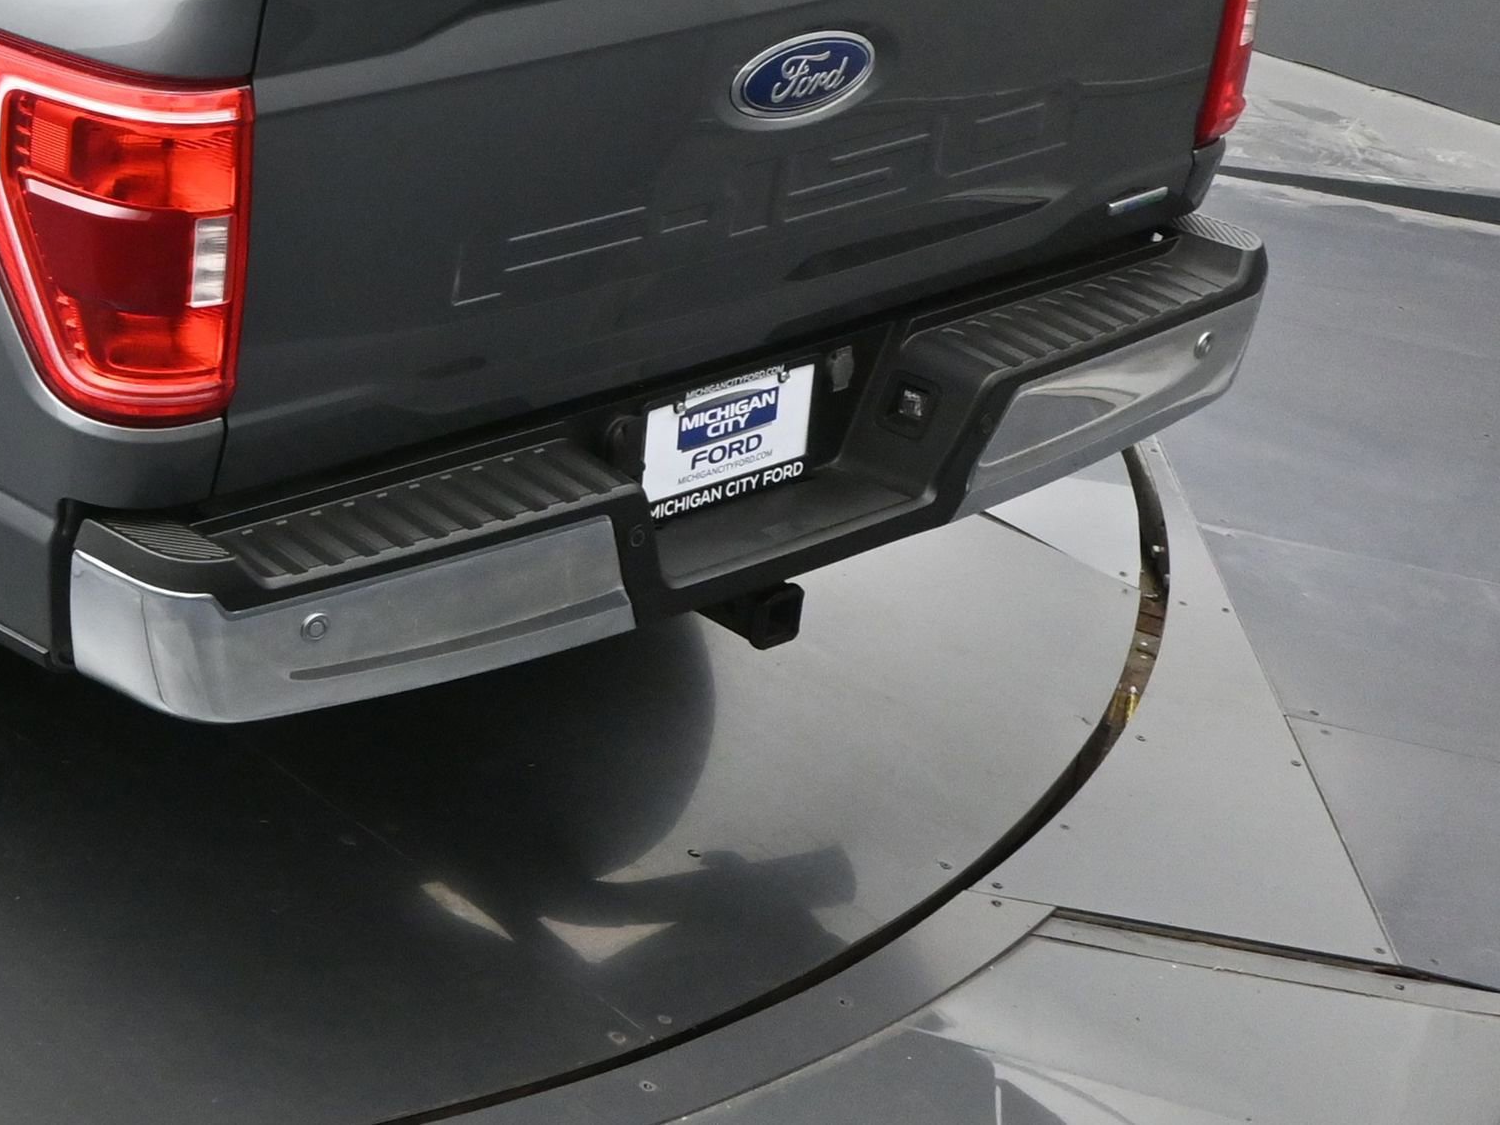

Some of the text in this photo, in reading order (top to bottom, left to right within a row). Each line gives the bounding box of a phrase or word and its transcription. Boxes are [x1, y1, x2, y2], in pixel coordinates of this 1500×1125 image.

[770, 50, 849, 104] Ford
[686, 365, 785, 399] MICHIGANCITYFORD.COM
[681, 390, 776, 432] MICHIGAN
[706, 413, 750, 438] CITY
[677, 449, 773, 485] MICHIGANCITYFORD.COM
[691, 433, 763, 470] FORD
[650, 461, 804, 519] MICHIGAN CITY FORD
